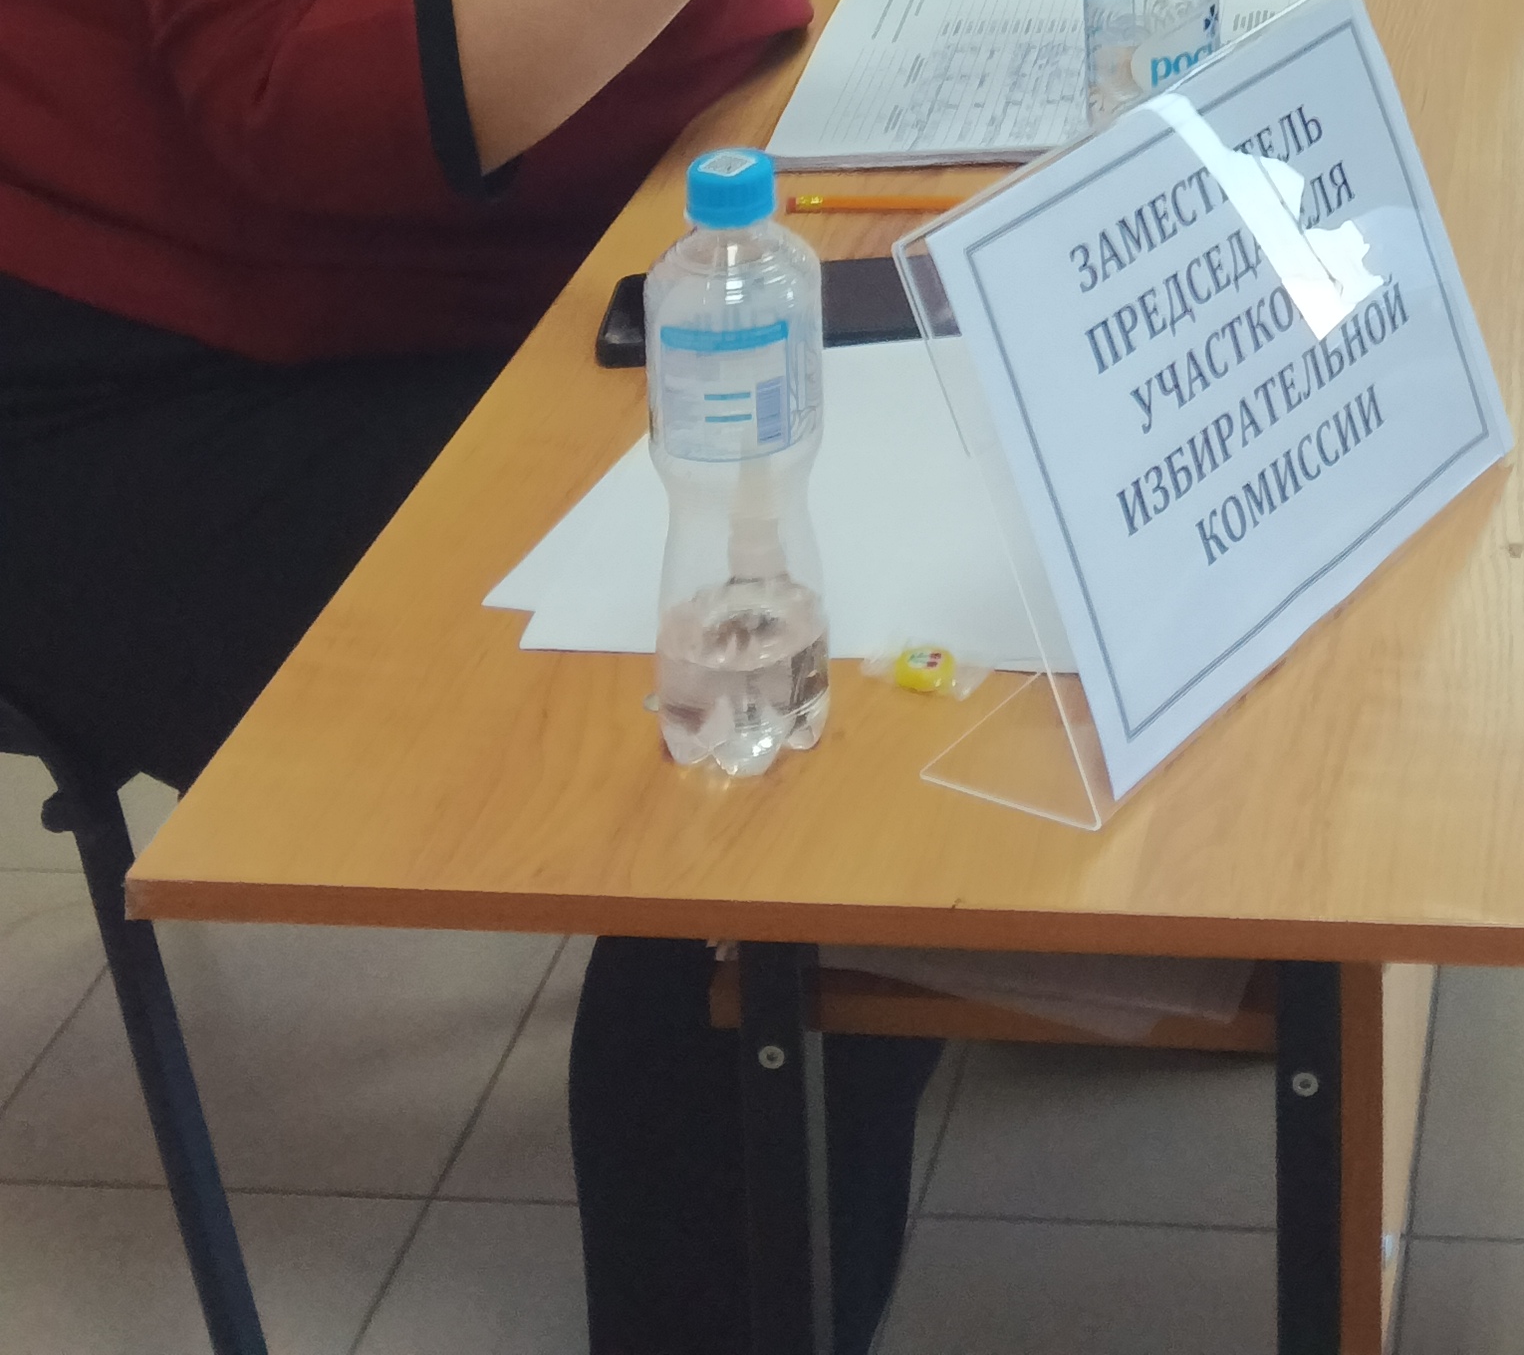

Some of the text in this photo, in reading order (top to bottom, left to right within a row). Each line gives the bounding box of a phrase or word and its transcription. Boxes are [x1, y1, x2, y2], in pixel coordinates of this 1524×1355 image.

[1084, 159, 1356, 374] ПРЕДСЕДЛЯ
[1130, 285, 1304, 435] УЧАСТКО
[1115, 272, 1410, 537] ИЗБИРАТЕЛЬНОЙ
[1194, 382, 1387, 567] КОМИССИИ
